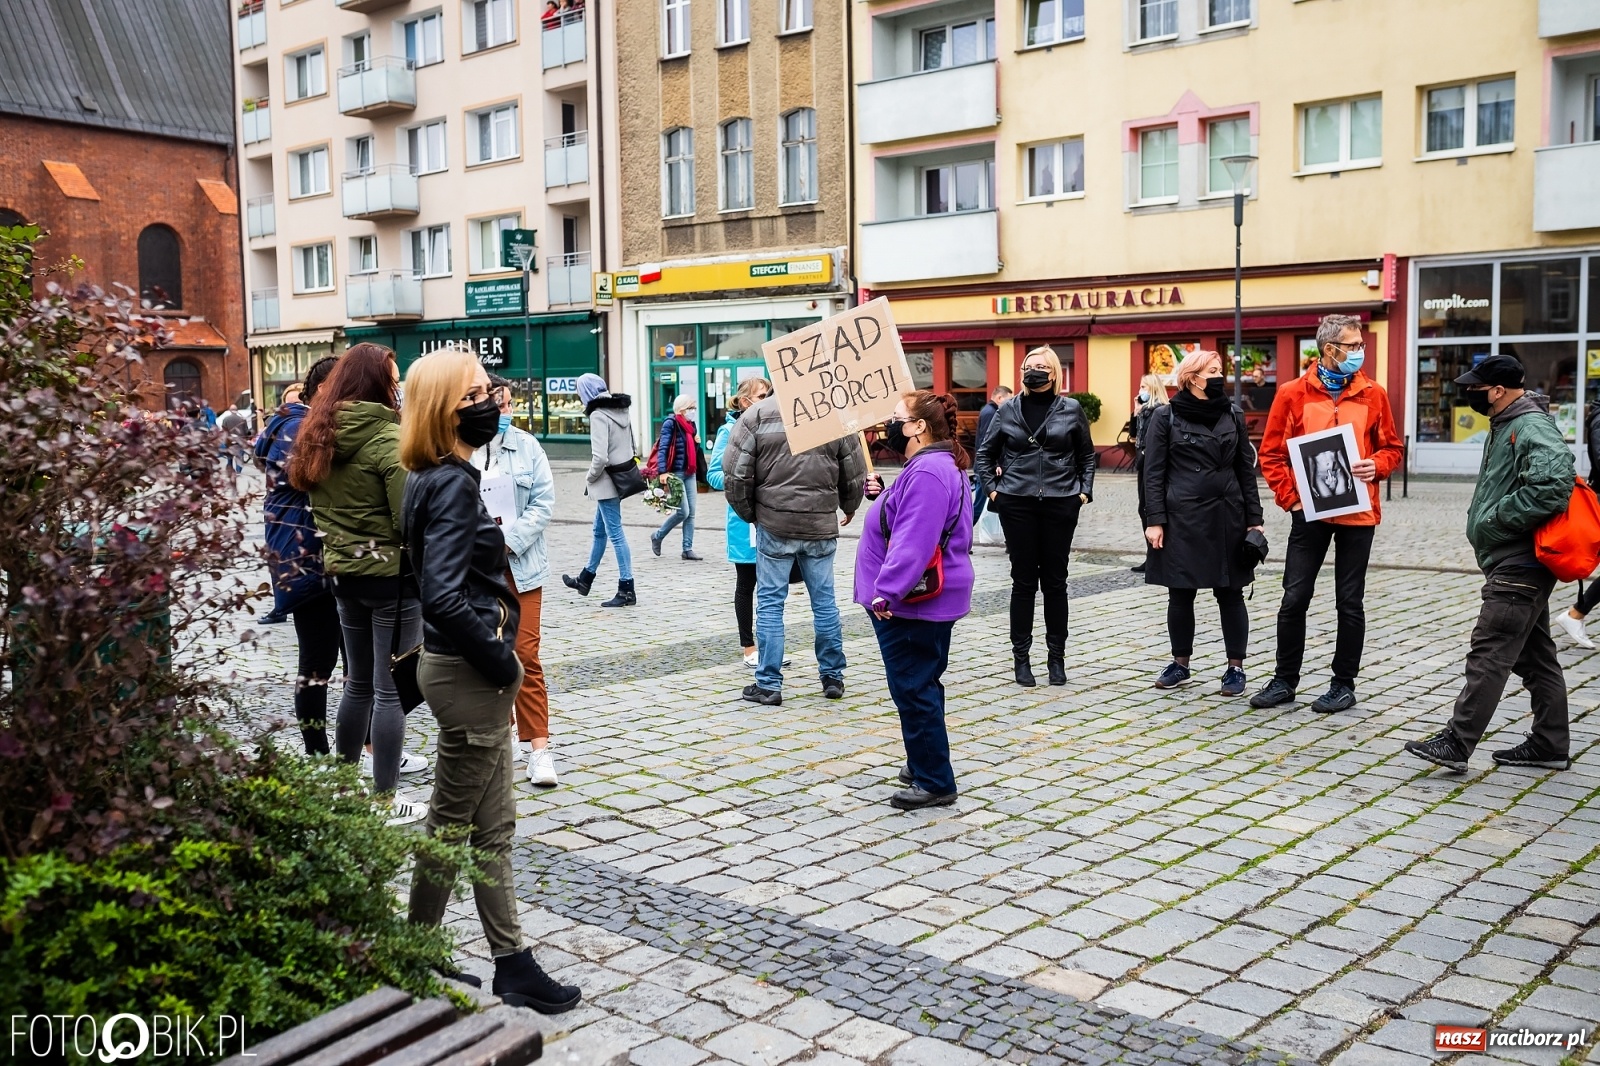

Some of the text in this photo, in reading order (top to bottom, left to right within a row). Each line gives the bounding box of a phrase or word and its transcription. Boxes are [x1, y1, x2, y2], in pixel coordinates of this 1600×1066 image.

[622, 276, 638, 284] KASA
[751, 261, 820, 275] STEFCZYK FINANSE
[1015, 286, 1183, 313] RESTAURACJA
[1423, 293, 1490, 311] empik.com
[776, 316, 882, 382] RZĄD
[265, 349, 325, 376] STELL
[549, 379, 577, 392] CAS
[819, 364, 849, 389] DO
[793, 365, 898, 427] ABORCJI
